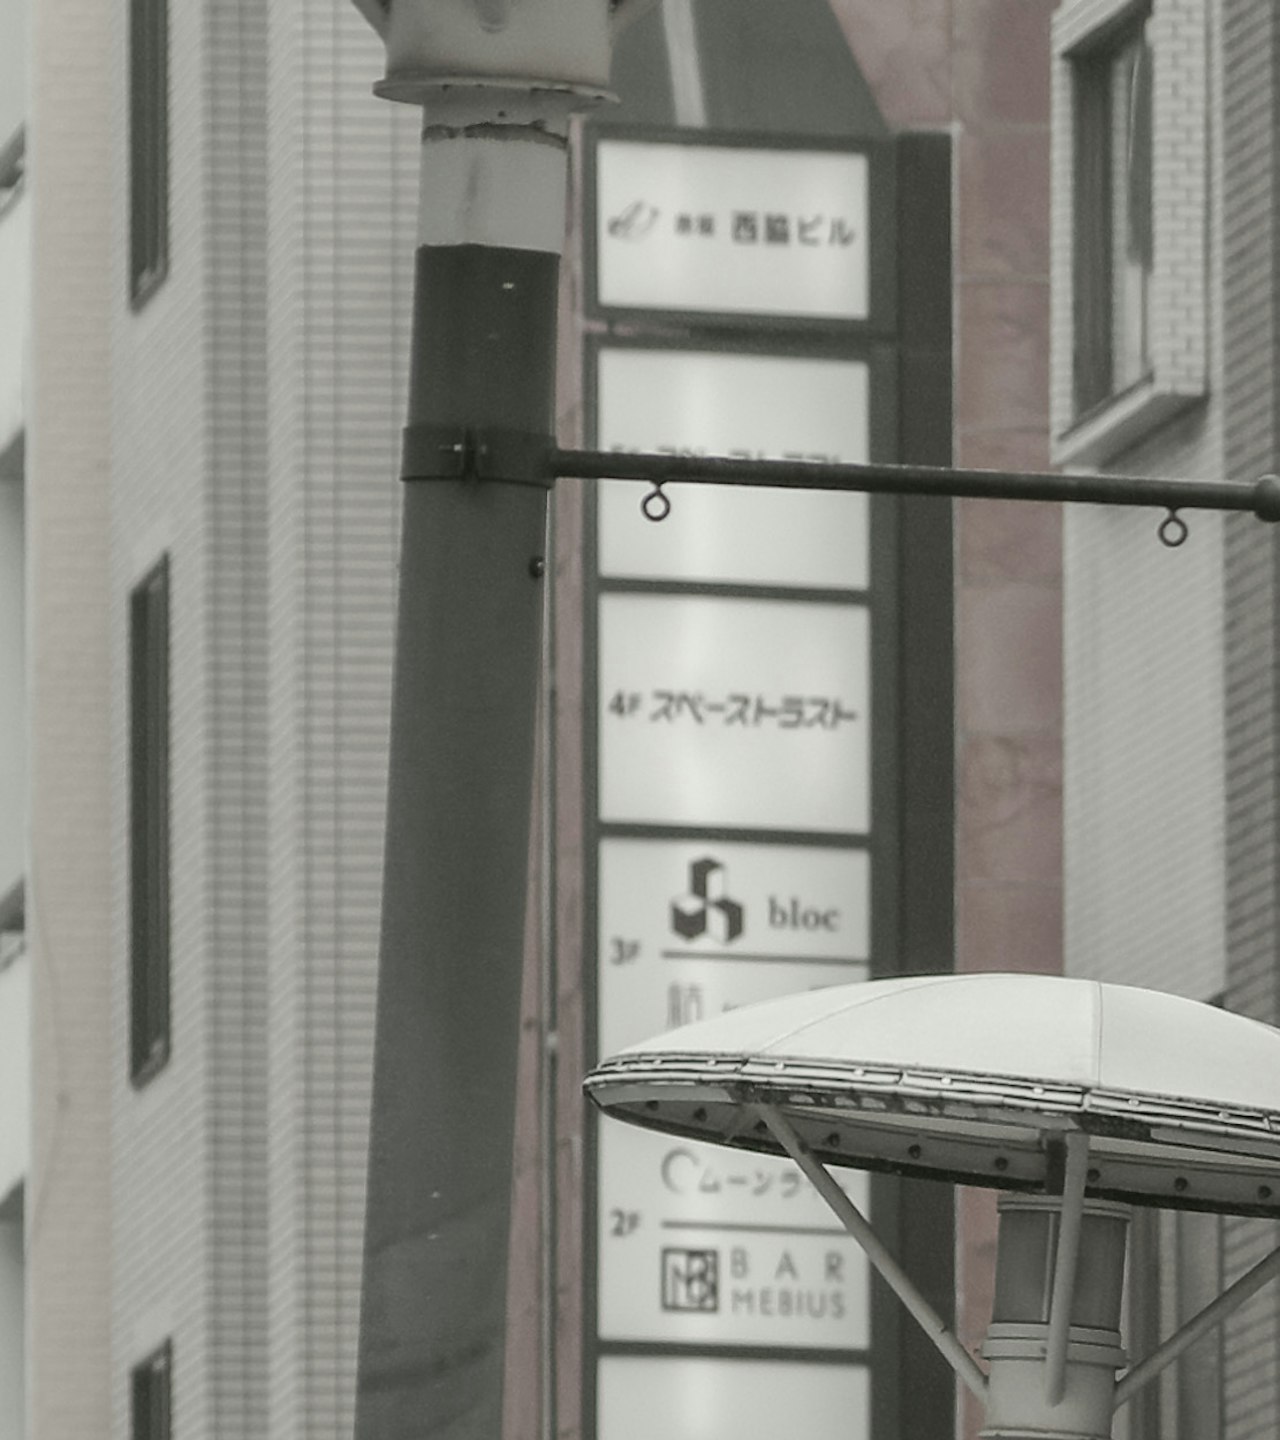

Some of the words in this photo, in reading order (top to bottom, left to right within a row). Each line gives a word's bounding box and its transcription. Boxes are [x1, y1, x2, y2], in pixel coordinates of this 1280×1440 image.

[649, 690, 857, 730] スペーストラスト
[767, 896, 839, 932] bloc
